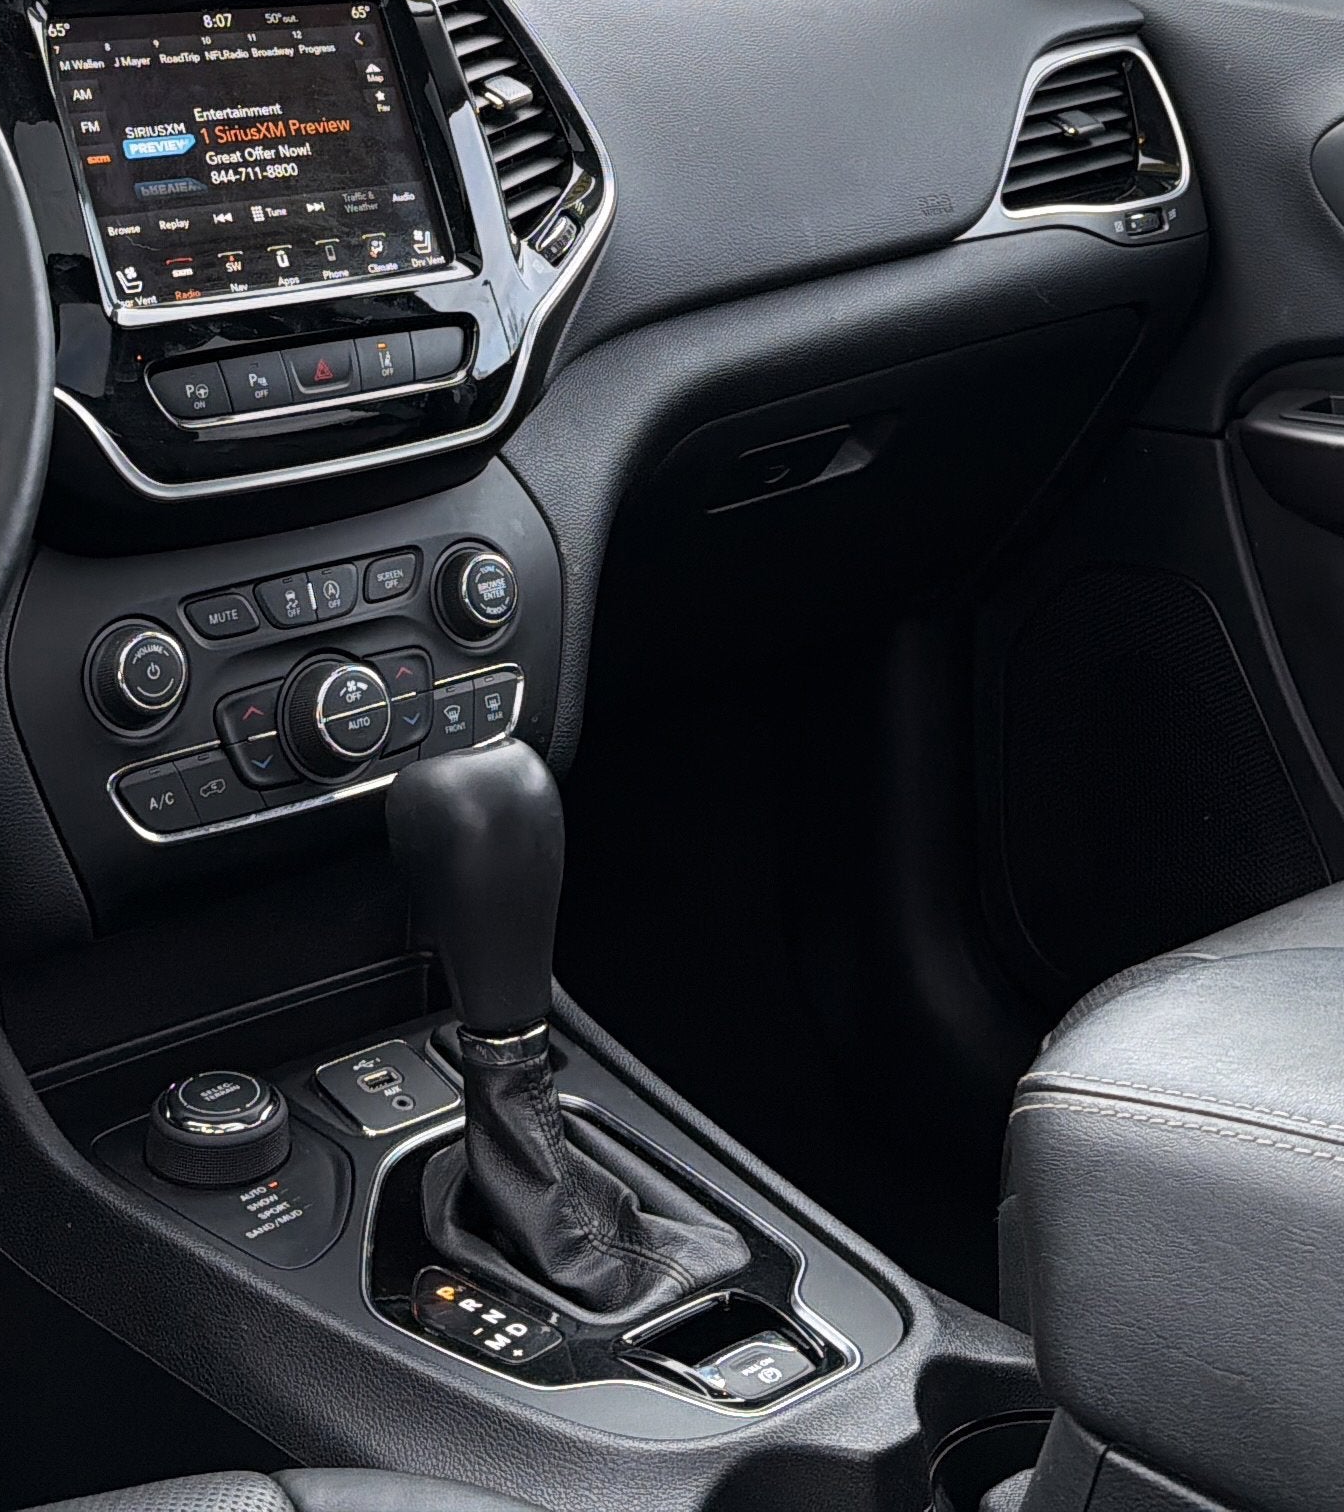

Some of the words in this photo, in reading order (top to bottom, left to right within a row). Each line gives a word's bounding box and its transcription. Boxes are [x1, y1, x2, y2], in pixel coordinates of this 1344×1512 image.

[203, 14, 232, 28] 8:07
[201, 36, 212, 45] 10
[247, 33, 257, 42] 11
[292, 30, 303, 40] 12
[104, 42, 111, 51] 8
[153, 39, 160, 48] 9
[251, 46, 294, 59] Broadway
[298, 44, 336, 56] Progress
[114, 57, 120, 68] J
[121, 56, 152, 69] Mayer
[159, 51, 201, 65] RoadTrip
[60, 60, 70, 71] M
[71, 58, 105, 70] Wallen
[73, 88, 93, 101] AM
[194, 103, 283, 121] Entertainment
[80, 120, 100, 133] FM
[125, 123, 186, 138] SIRIUSXM
[200, 128, 210, 144] 1
[215, 121, 286, 143] SiriusXM
[290, 118, 351, 136] Preview
[129, 139, 189, 155] PREVIEW
[206, 150, 242, 165] Great
[245, 146, 275, 161] Offer
[279, 143, 311, 157] Now!
[211, 163, 298, 184] 844-711-8800
[342, 193, 367, 201] Traffic
[392, 192, 415, 202] Audio
[265, 207, 287, 217] Tune
[344, 203, 378, 213] Weather
[107, 225, 141, 237] Browse
[159, 219, 189, 231] Replay
[225, 261, 242, 272] SW
[428, 256, 445, 265] Vent
[322, 268, 349, 279] Phone
[368, 262, 399, 273] Climate
[230, 283, 248, 292] Nav
[278, 276, 300, 288] Apps
[135, 295, 158, 306] Vent
[175, 289, 201, 300] Radio
[381, 367, 394, 377] OFF
[255, 390, 268, 399] OFF
[194, 400, 206, 410] ON
[377, 568, 405, 582] SCREEN
[384, 579, 400, 590] OFF
[477, 577, 507, 593] BROWSE
[483, 588, 505, 602] ENTER
[328, 598, 342, 609] OFF
[209, 609, 239, 625] MUTE
[287, 607, 302, 618] OFF
[135, 644, 164, 660] VOLUME
[345, 691, 362, 704] OFF
[487, 711, 504, 722] REAR
[348, 716, 371, 731] AUTO
[445, 722, 467, 734] FRONT
[149, 792, 175, 811] A/C
[203, 1084, 241, 1102] TERRAIN
[384, 1086, 402, 1097] AUX
[240, 1186, 267, 1202] AUTO
[247, 1193, 278, 1212] SNOW
[258, 1201, 291, 1220] SPORT
[436, 1286, 456, 1301] P
[458, 1298, 483, 1312] R
[481, 1308, 507, 1325] N
[505, 1323, 529, 1338] D
[483, 1333, 512, 1351] M
